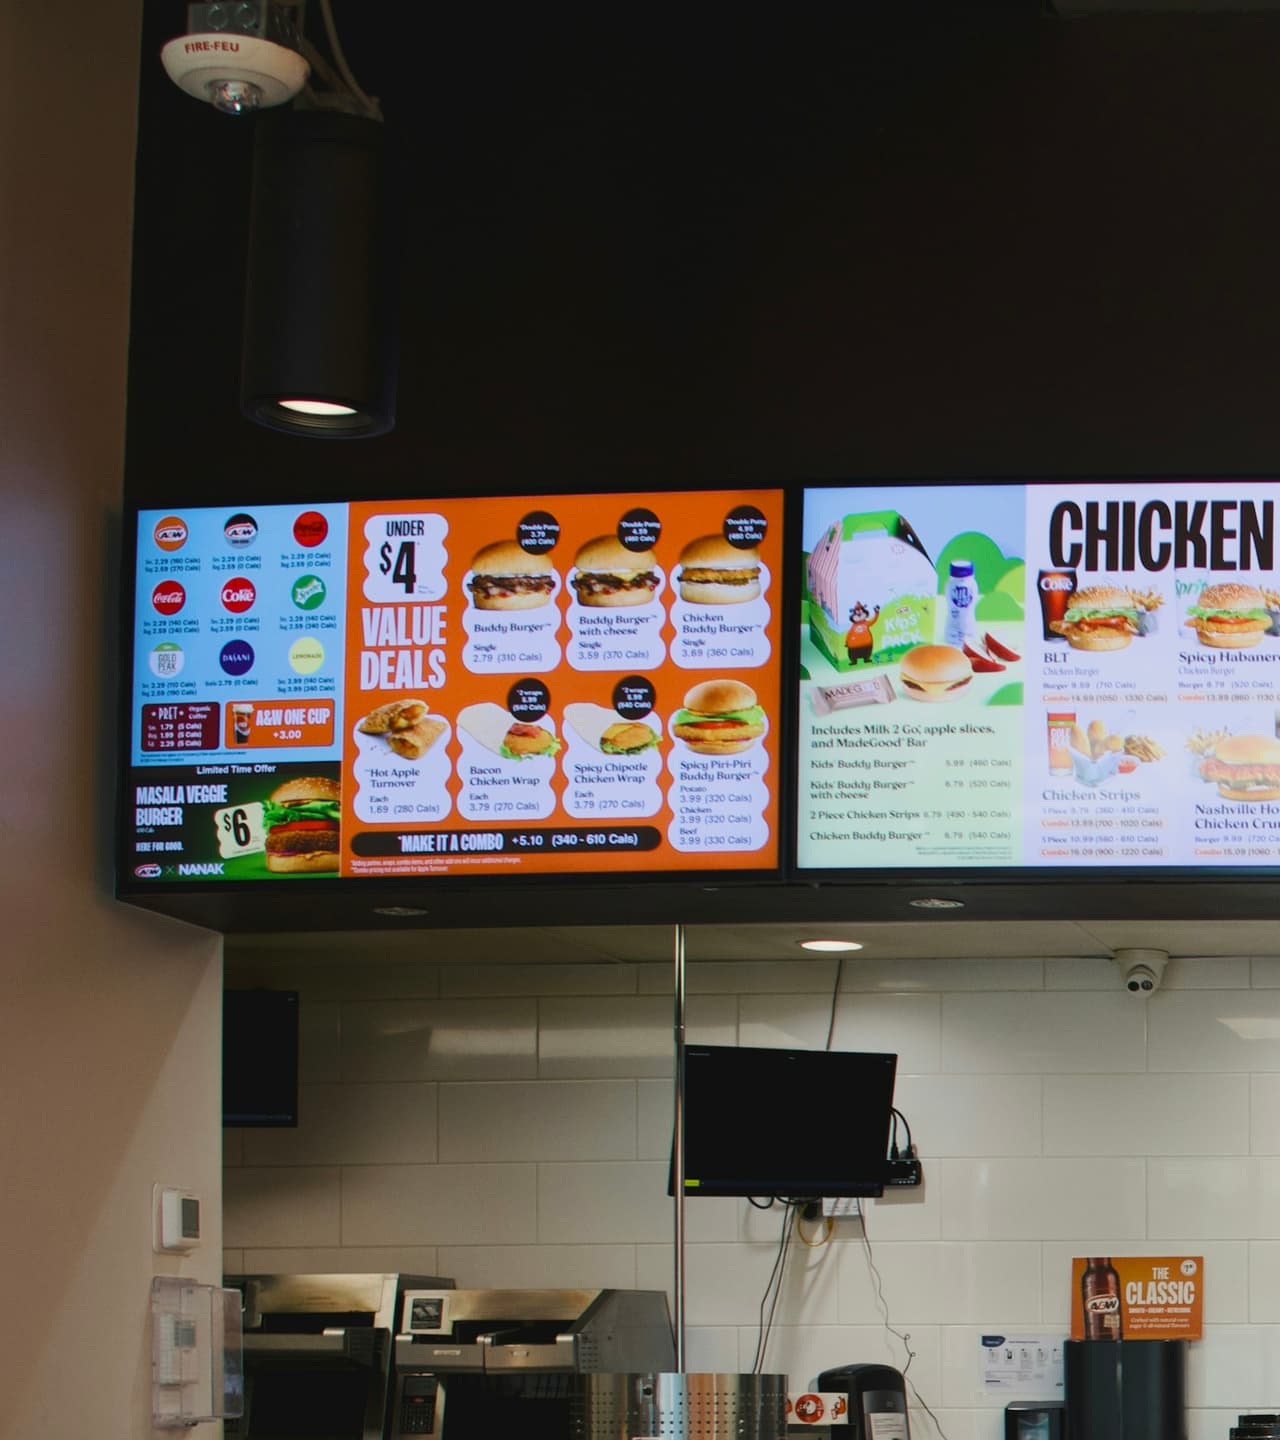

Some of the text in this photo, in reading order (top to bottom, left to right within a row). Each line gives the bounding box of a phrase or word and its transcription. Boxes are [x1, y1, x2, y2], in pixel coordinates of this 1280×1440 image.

[184, 41, 239, 53] FIRE-FEU
[387, 521, 424, 537] UNDER
[1049, 499, 1274, 572] CHICKEN
[362, 606, 447, 646] VALUE
[1044, 652, 1069, 664] BLT
[1179, 651, 1216, 664] Spicy
[360, 650, 446, 690] DEALS
[256, 708, 330, 726] A&W ONE CUP
[197, 766, 229, 774] Limited
[255, 765, 276, 773] Offer
[391, 768, 420, 778] Apple
[470, 766, 501, 775] Bacon
[371, 780, 416, 788] Turnover
[470, 777, 540, 786] Chicken Wrap
[136, 785, 227, 805] MASALA VEGGIE
[416, 804, 440, 813] Cals)
[1195, 804, 1256, 815] Nashville
[136, 807, 182, 826] BURGER
[810, 810, 920, 820] 2 Piece Chicken Strips
[223, 809, 250, 846] $6
[1195, 818, 1249, 829] Chicken
[437, 835, 448, 851] IT
[450, 835, 459, 851] A
[461, 833, 503, 850] COMBO
[512, 835, 543, 845] +5.10
[552, 835, 578, 845] (340
[609, 834, 638, 845] Cals)
[179, 863, 224, 875] NANAK
[1152, 1267, 1169, 1280] THE
[1126, 1281, 1195, 1305] CLASSIC
[1091, 1300, 1117, 1310] A&W
